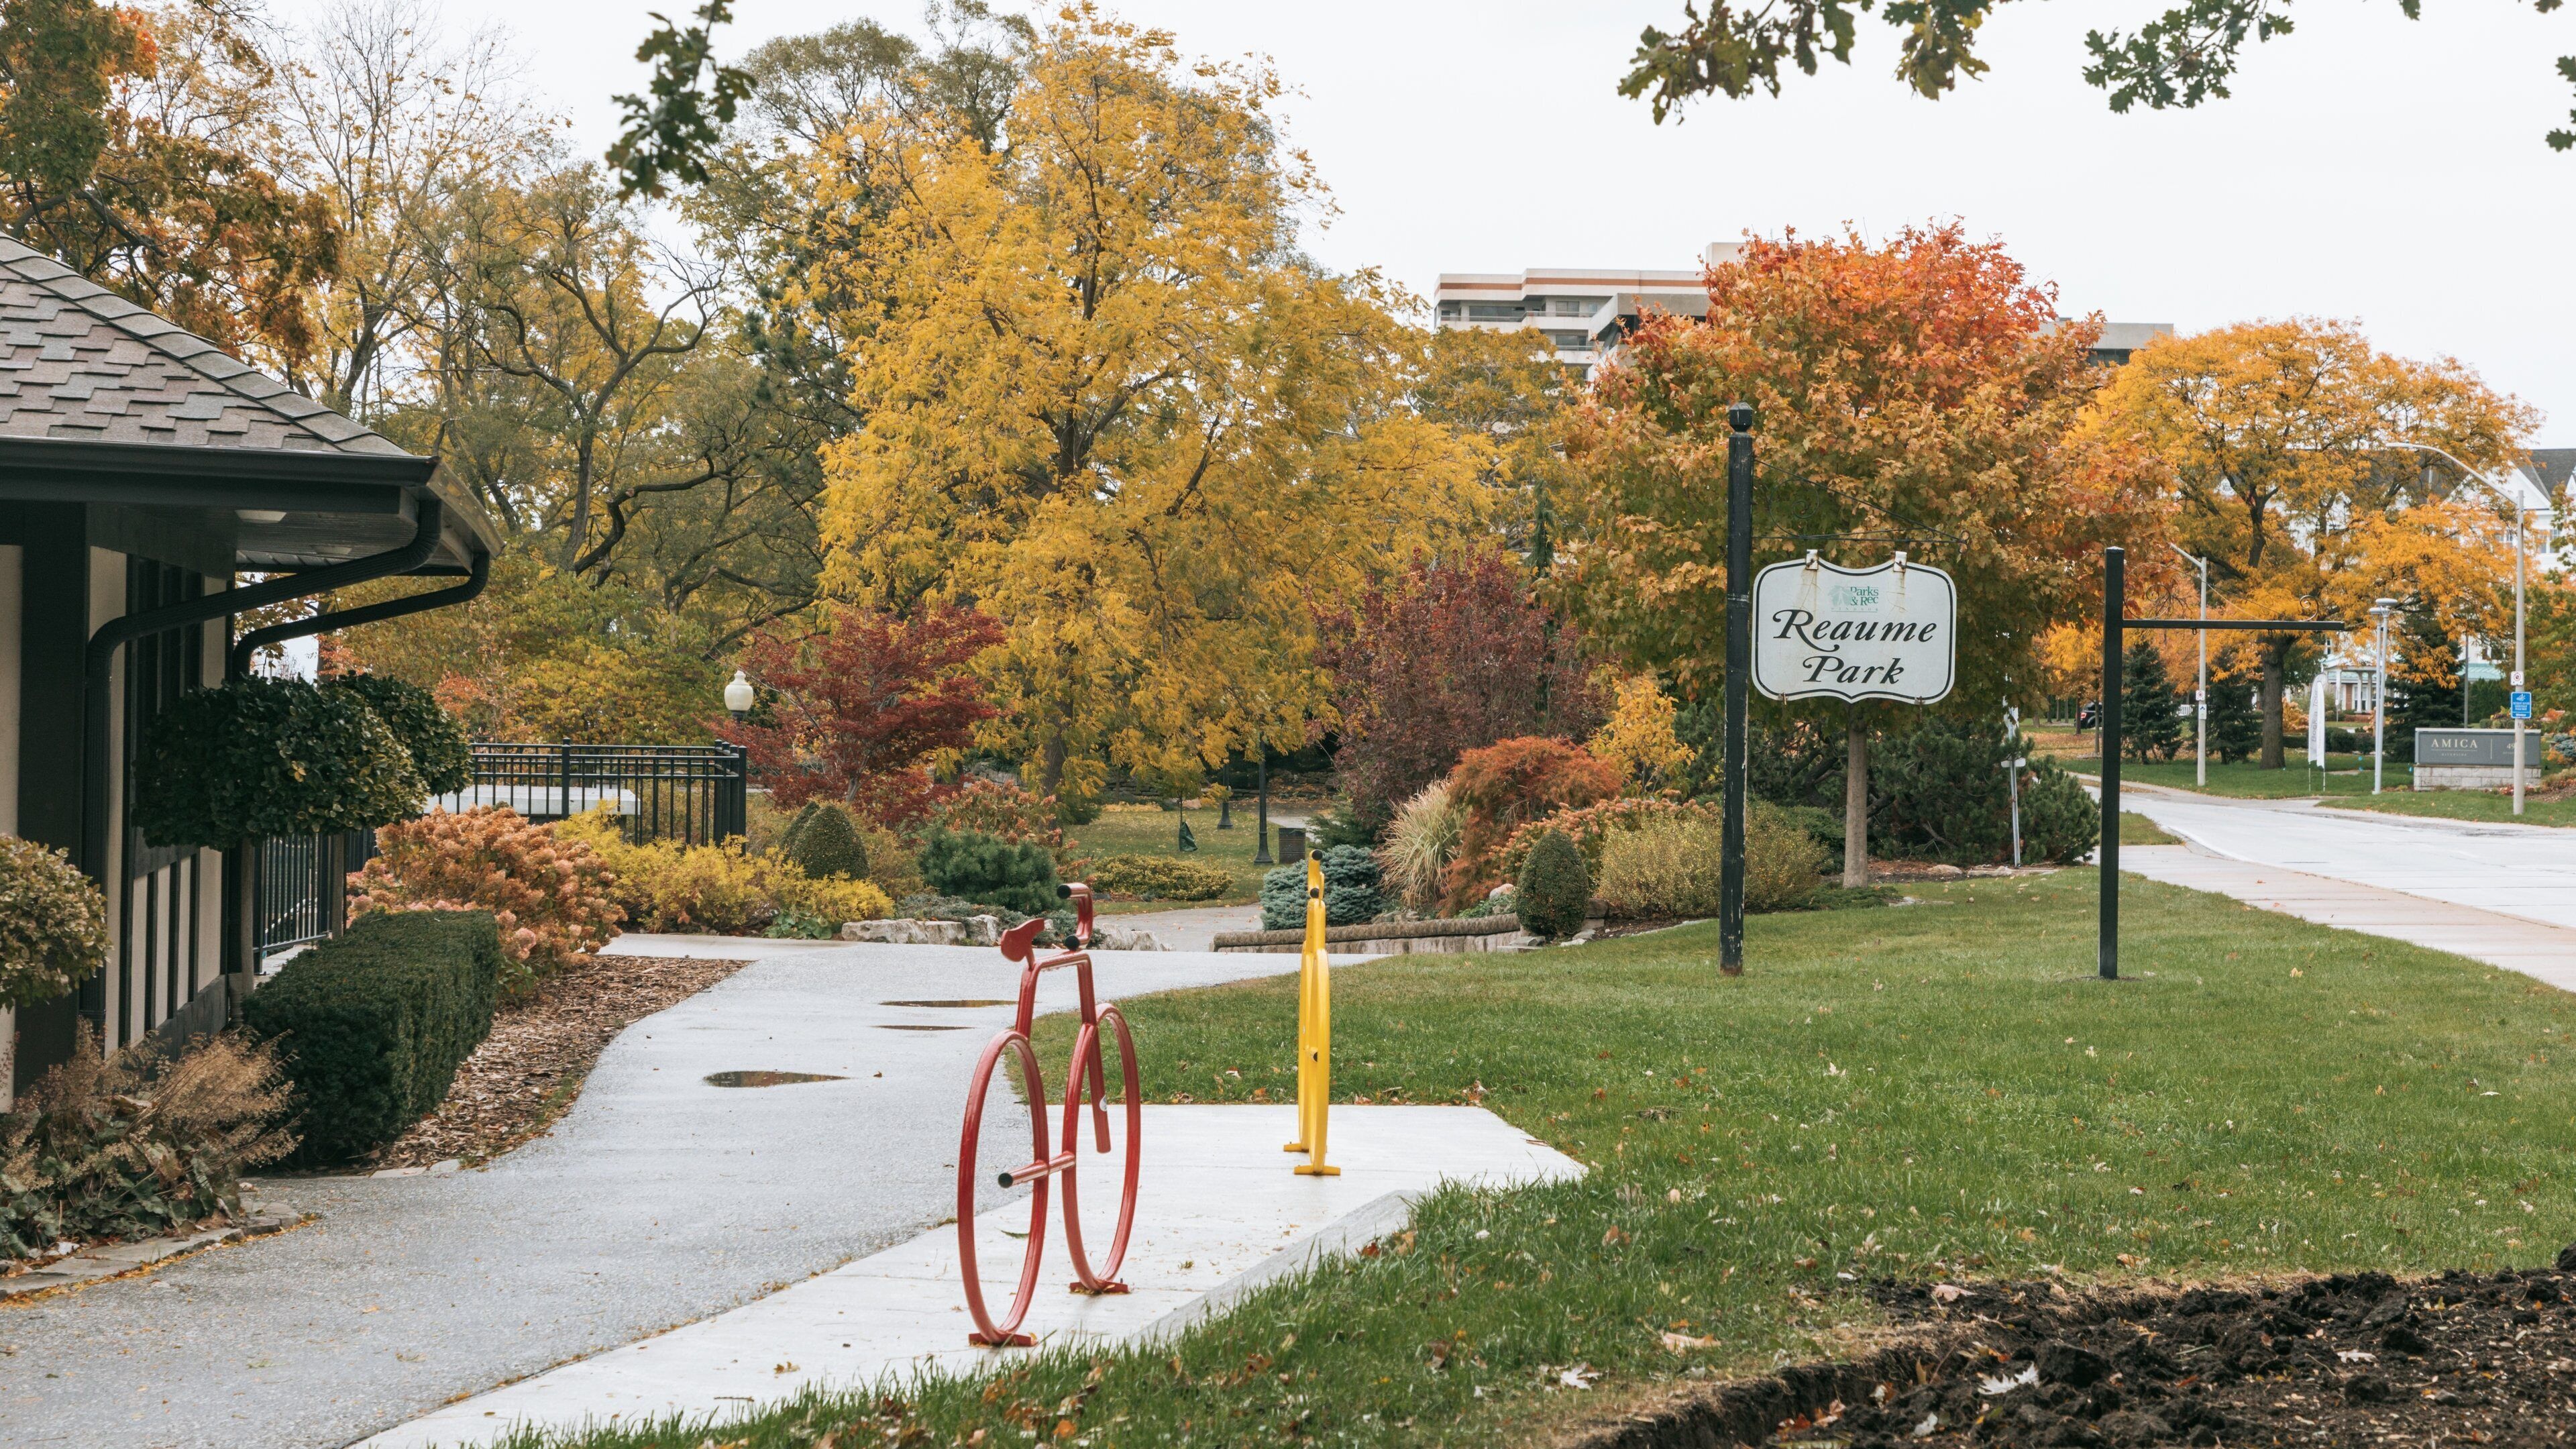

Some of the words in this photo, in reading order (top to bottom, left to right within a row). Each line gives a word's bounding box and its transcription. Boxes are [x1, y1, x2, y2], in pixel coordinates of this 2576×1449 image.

[1850, 586, 1879, 596] Parks
[1849, 596, 1859, 606] &
[1860, 596, 1879, 606] Rec
[1772, 609, 1937, 652] Reaume
[1803, 655, 1904, 685] Park
[2430, 739, 2478, 749] AMICA
